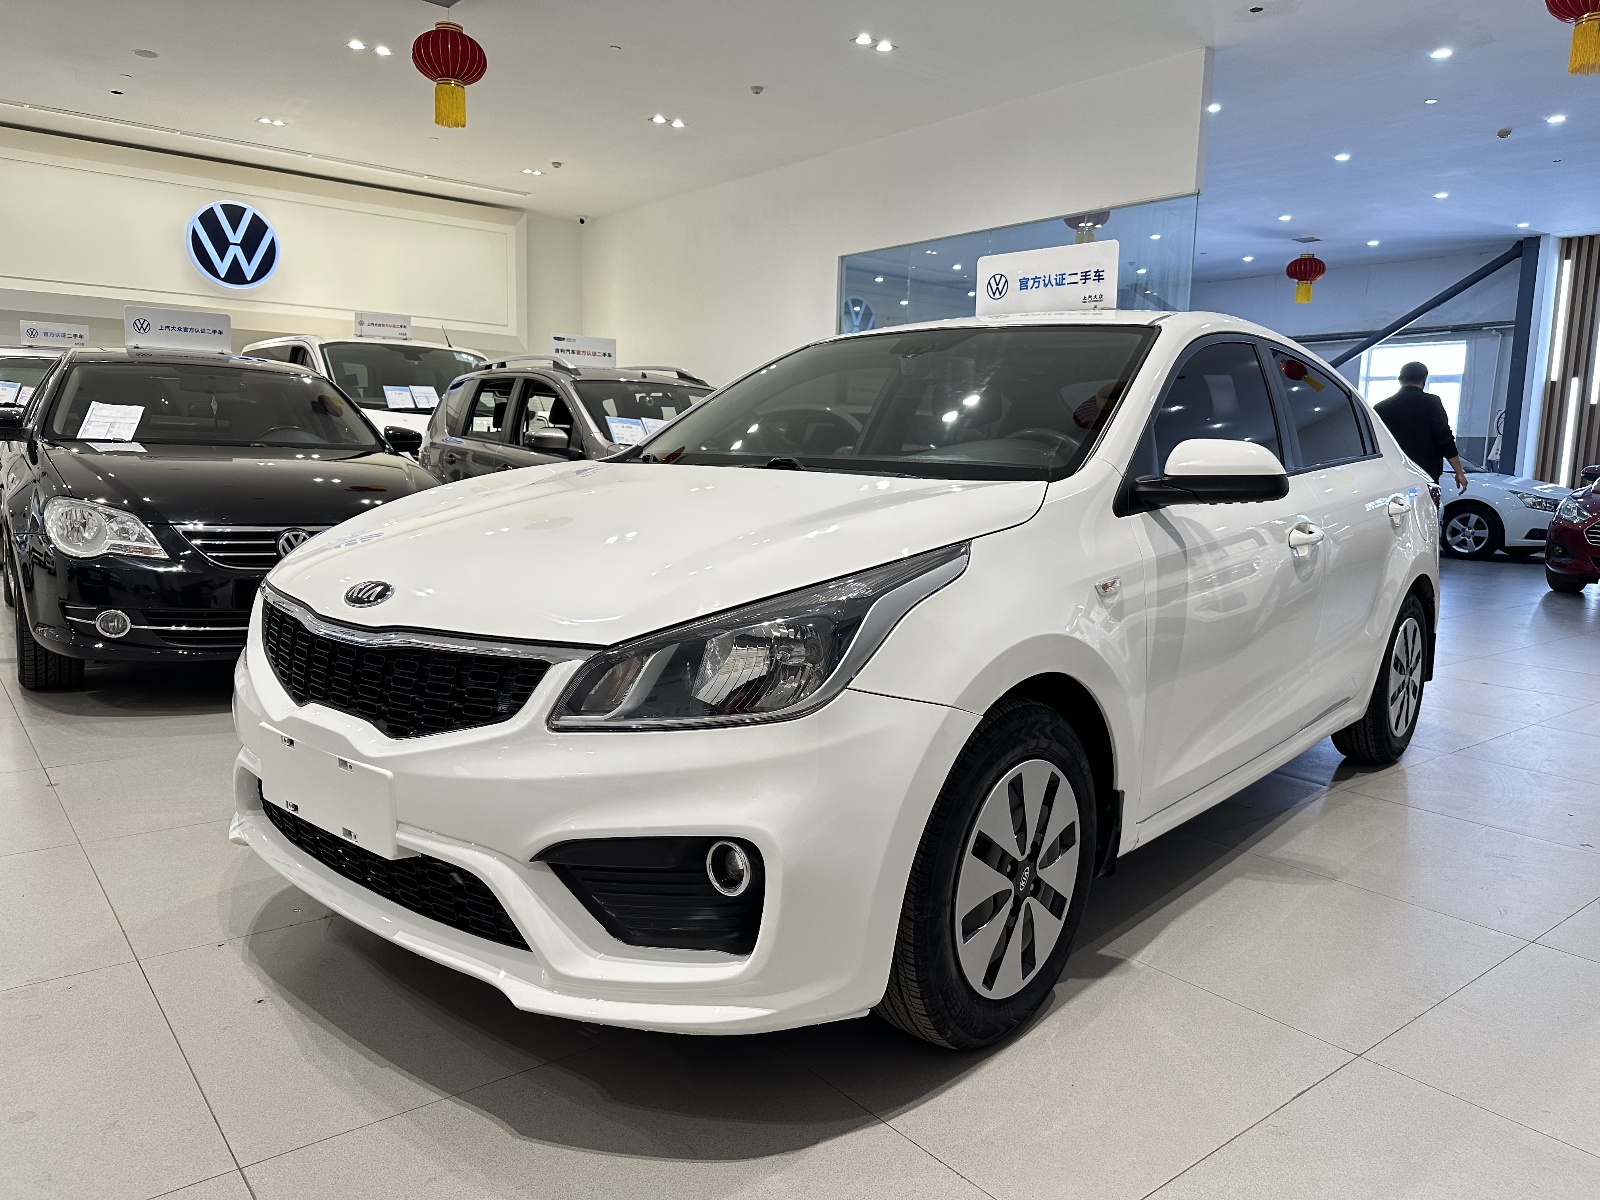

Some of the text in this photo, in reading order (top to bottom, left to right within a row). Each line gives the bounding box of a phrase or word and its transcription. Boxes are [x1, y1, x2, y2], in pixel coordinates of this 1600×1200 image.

[187, 200, 279, 289] VW
[986, 273, 1009, 300] VW
[1018, 269, 1105, 291] 官方认证二手车
[133, 318, 151, 334] VW
[158, 324, 224, 335] 上汽大众官方认证二手车
[346, 582, 388, 604] KIA
[1020, 868, 1029, 889] KIA
